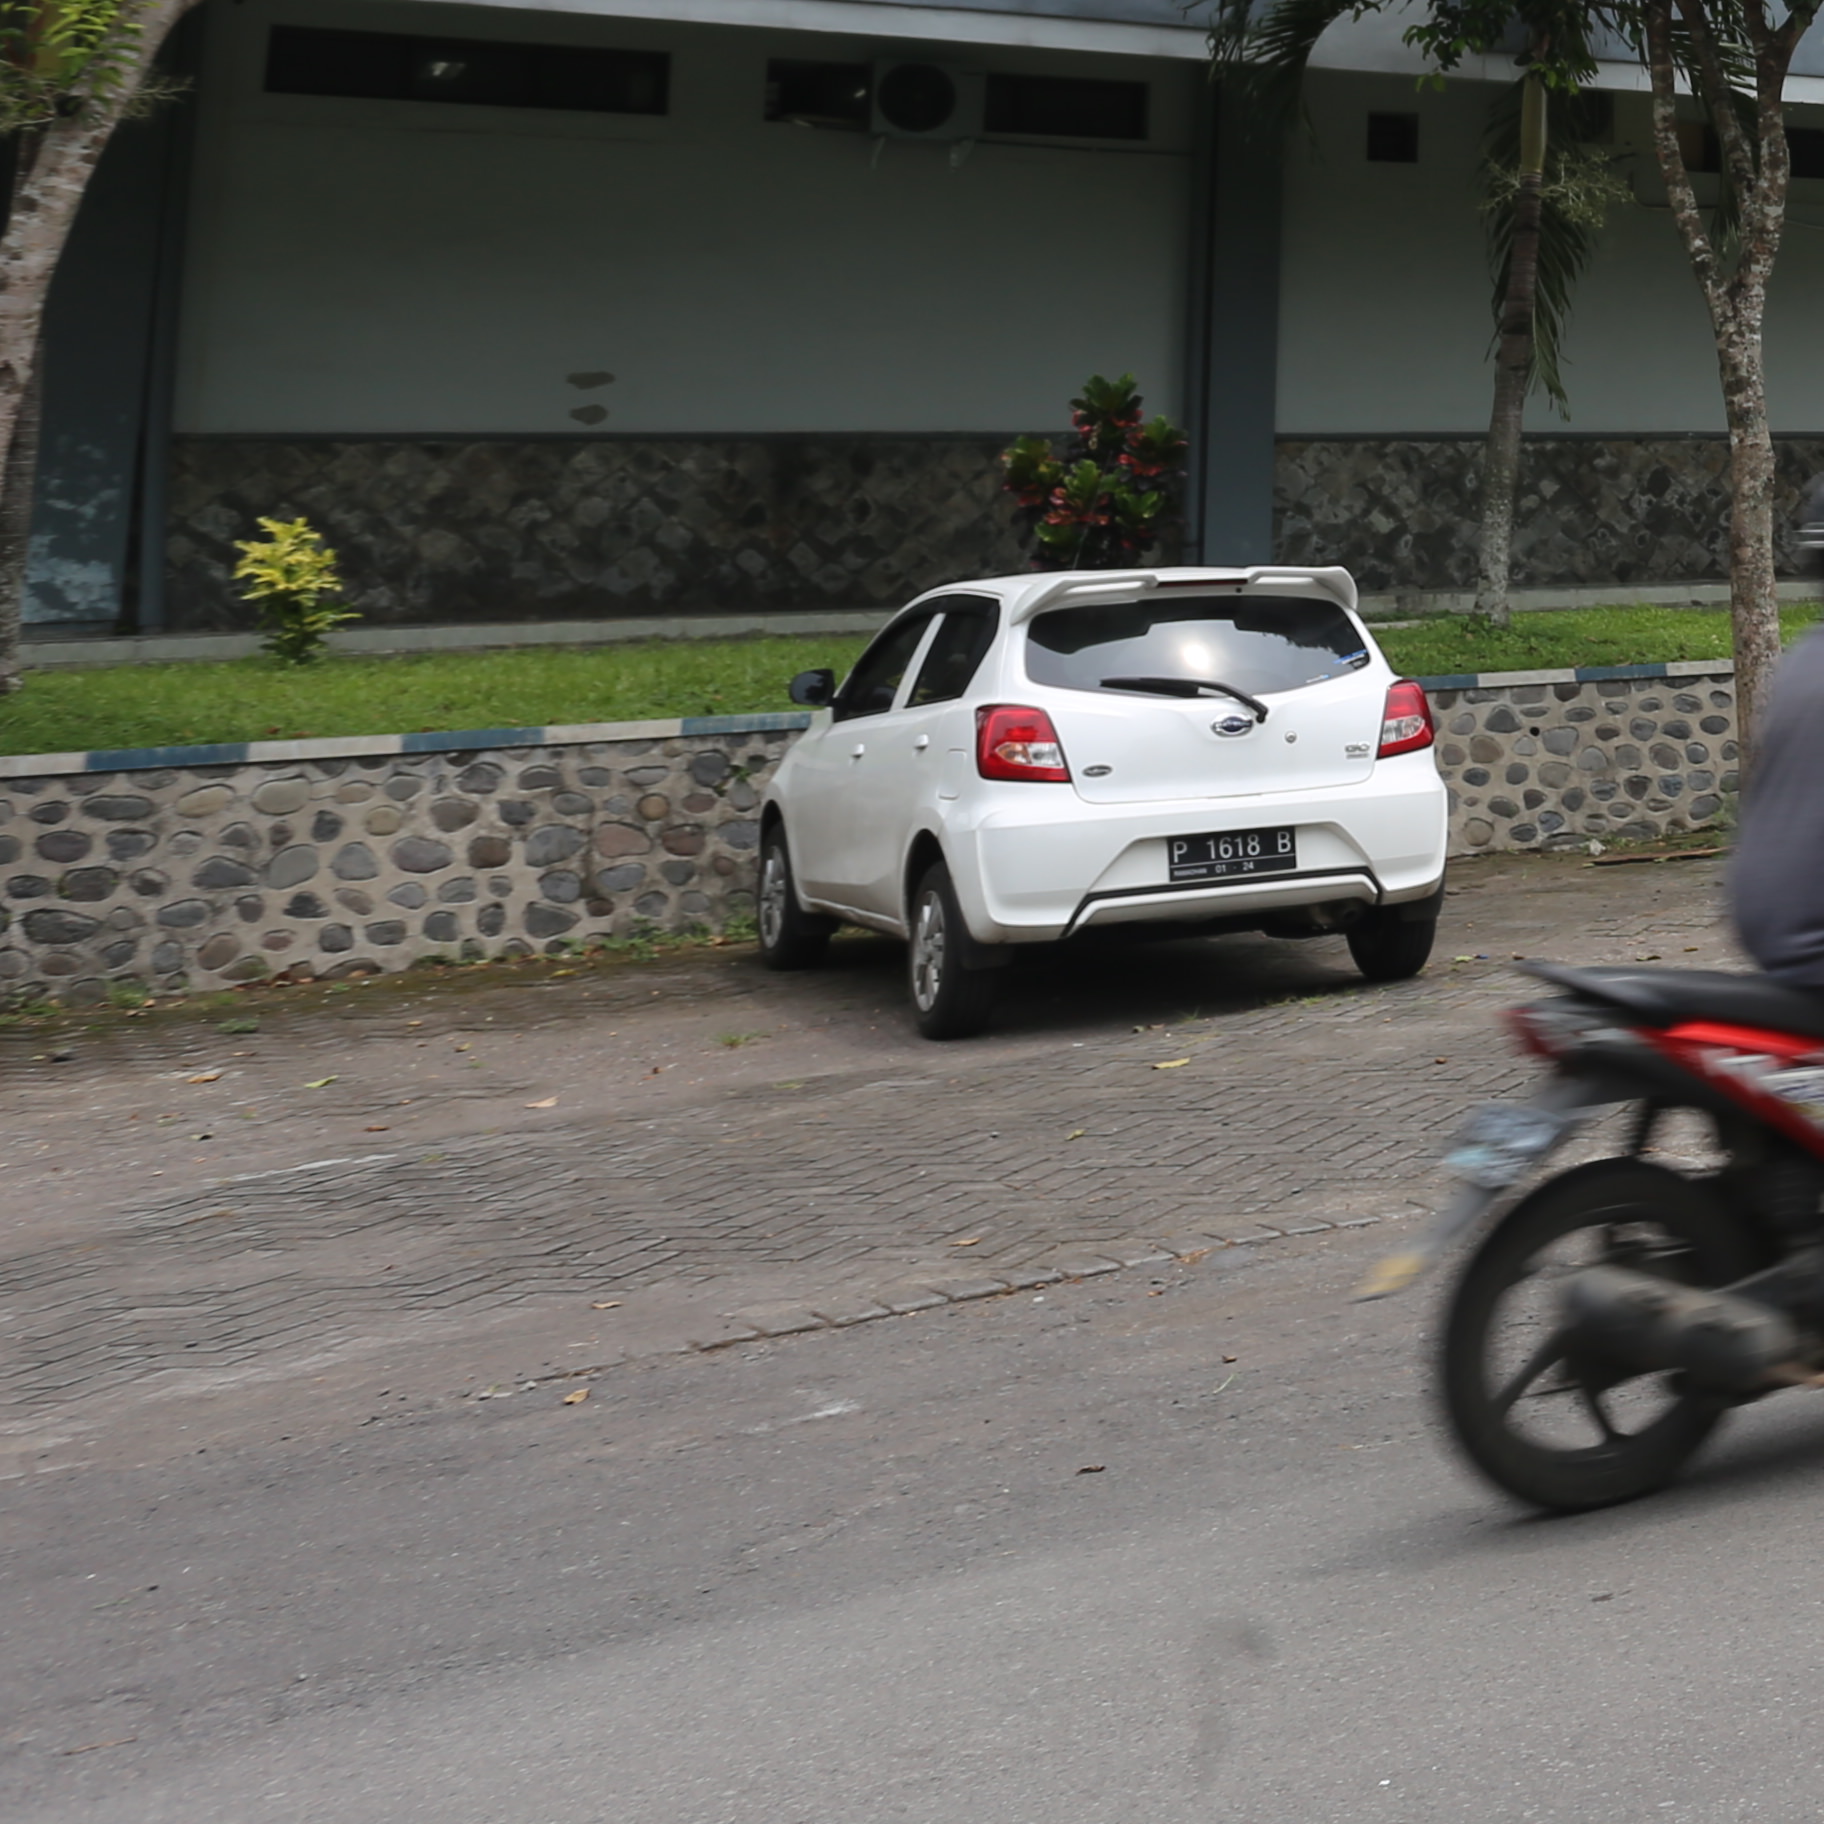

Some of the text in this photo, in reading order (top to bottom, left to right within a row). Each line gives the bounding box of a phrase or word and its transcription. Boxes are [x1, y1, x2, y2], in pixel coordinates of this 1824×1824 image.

[1173, 831, 1292, 864] P 1618 B
[1215, 864, 1227, 874] 01
[1242, 861, 1255, 871] 24
